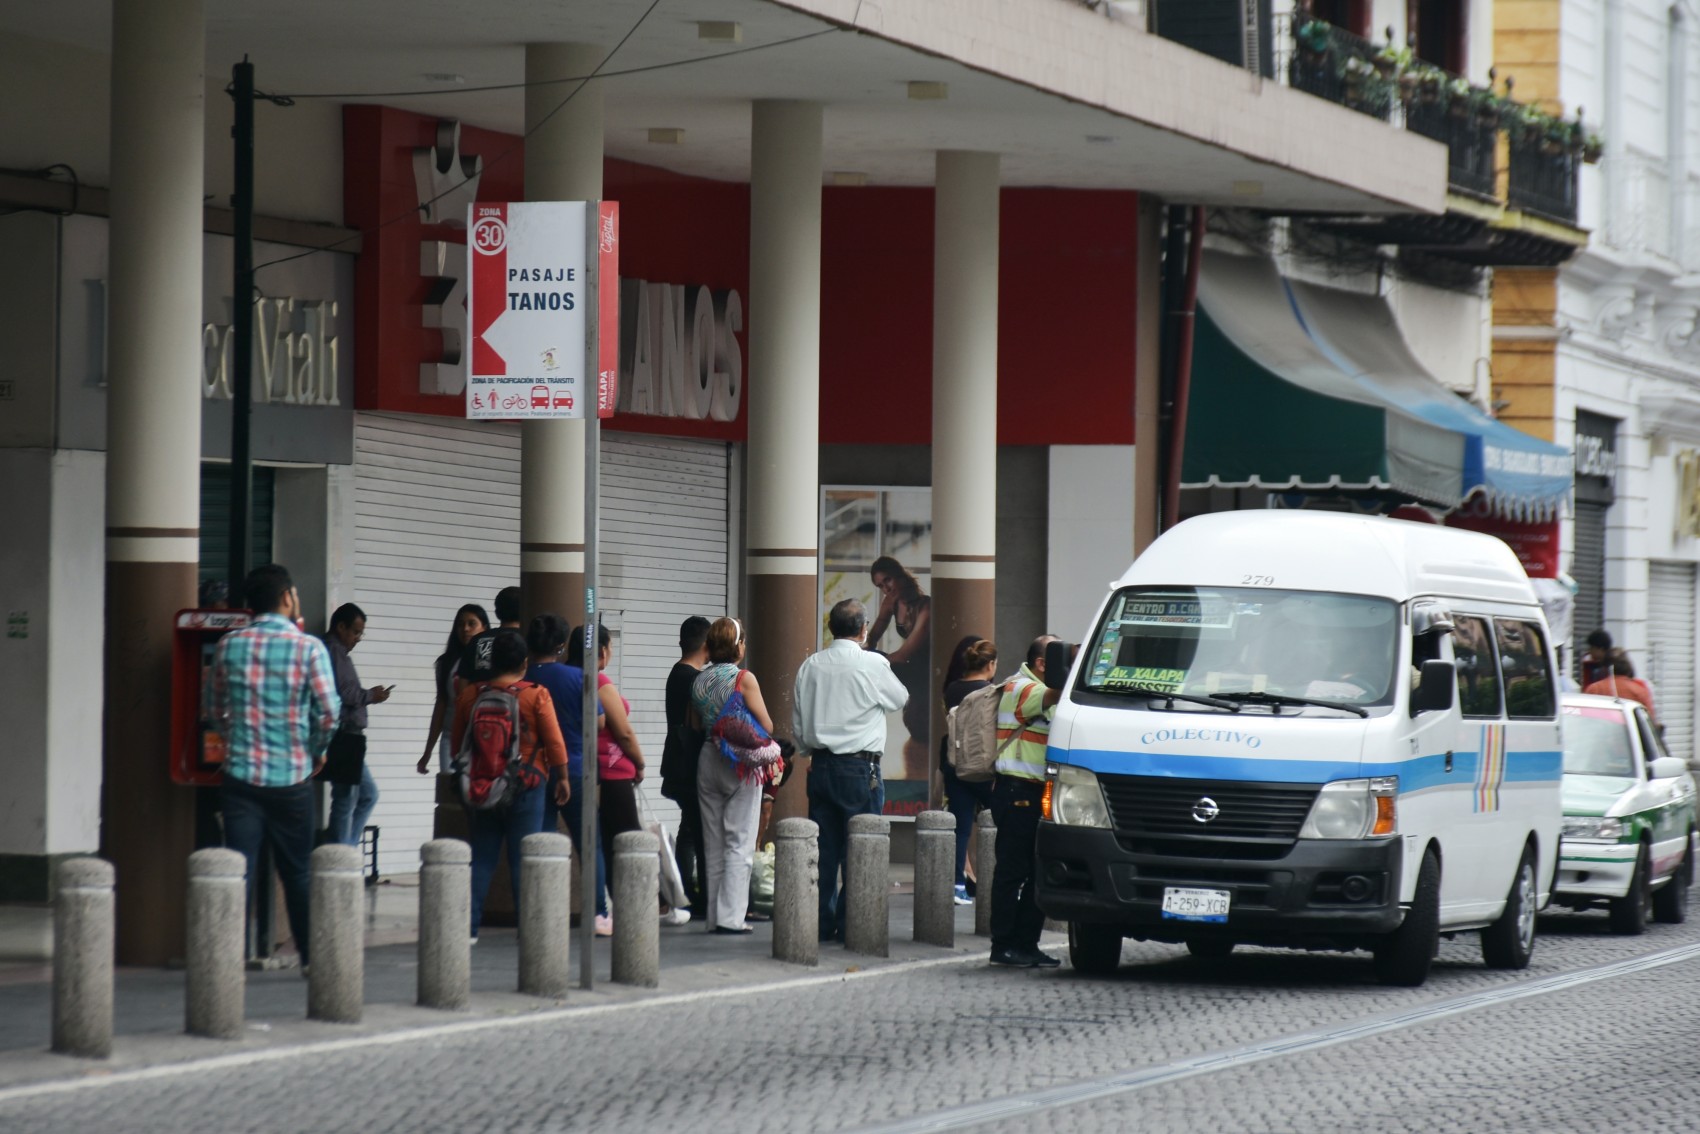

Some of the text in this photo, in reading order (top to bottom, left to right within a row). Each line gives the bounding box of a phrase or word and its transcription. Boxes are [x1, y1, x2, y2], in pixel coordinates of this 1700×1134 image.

[479, 208, 501, 216] ZONA
[477, 225, 501, 247] 30
[508, 268, 575, 282] PASAJE
[508, 292, 575, 311] TANOS
[628, 279, 743, 422] ANOS
[496, 376, 534, 384] PACIFICACIÓN
[547, 376, 575, 384] TRÁNSITO
[599, 370, 608, 410] XALAPA
[1241, 574, 1275, 586] 279
[1126, 603, 1165, 614] CENTRO
[1109, 667, 1185, 683] Av. XALAPA
[1141, 728, 1261, 749] COLECTIVO
